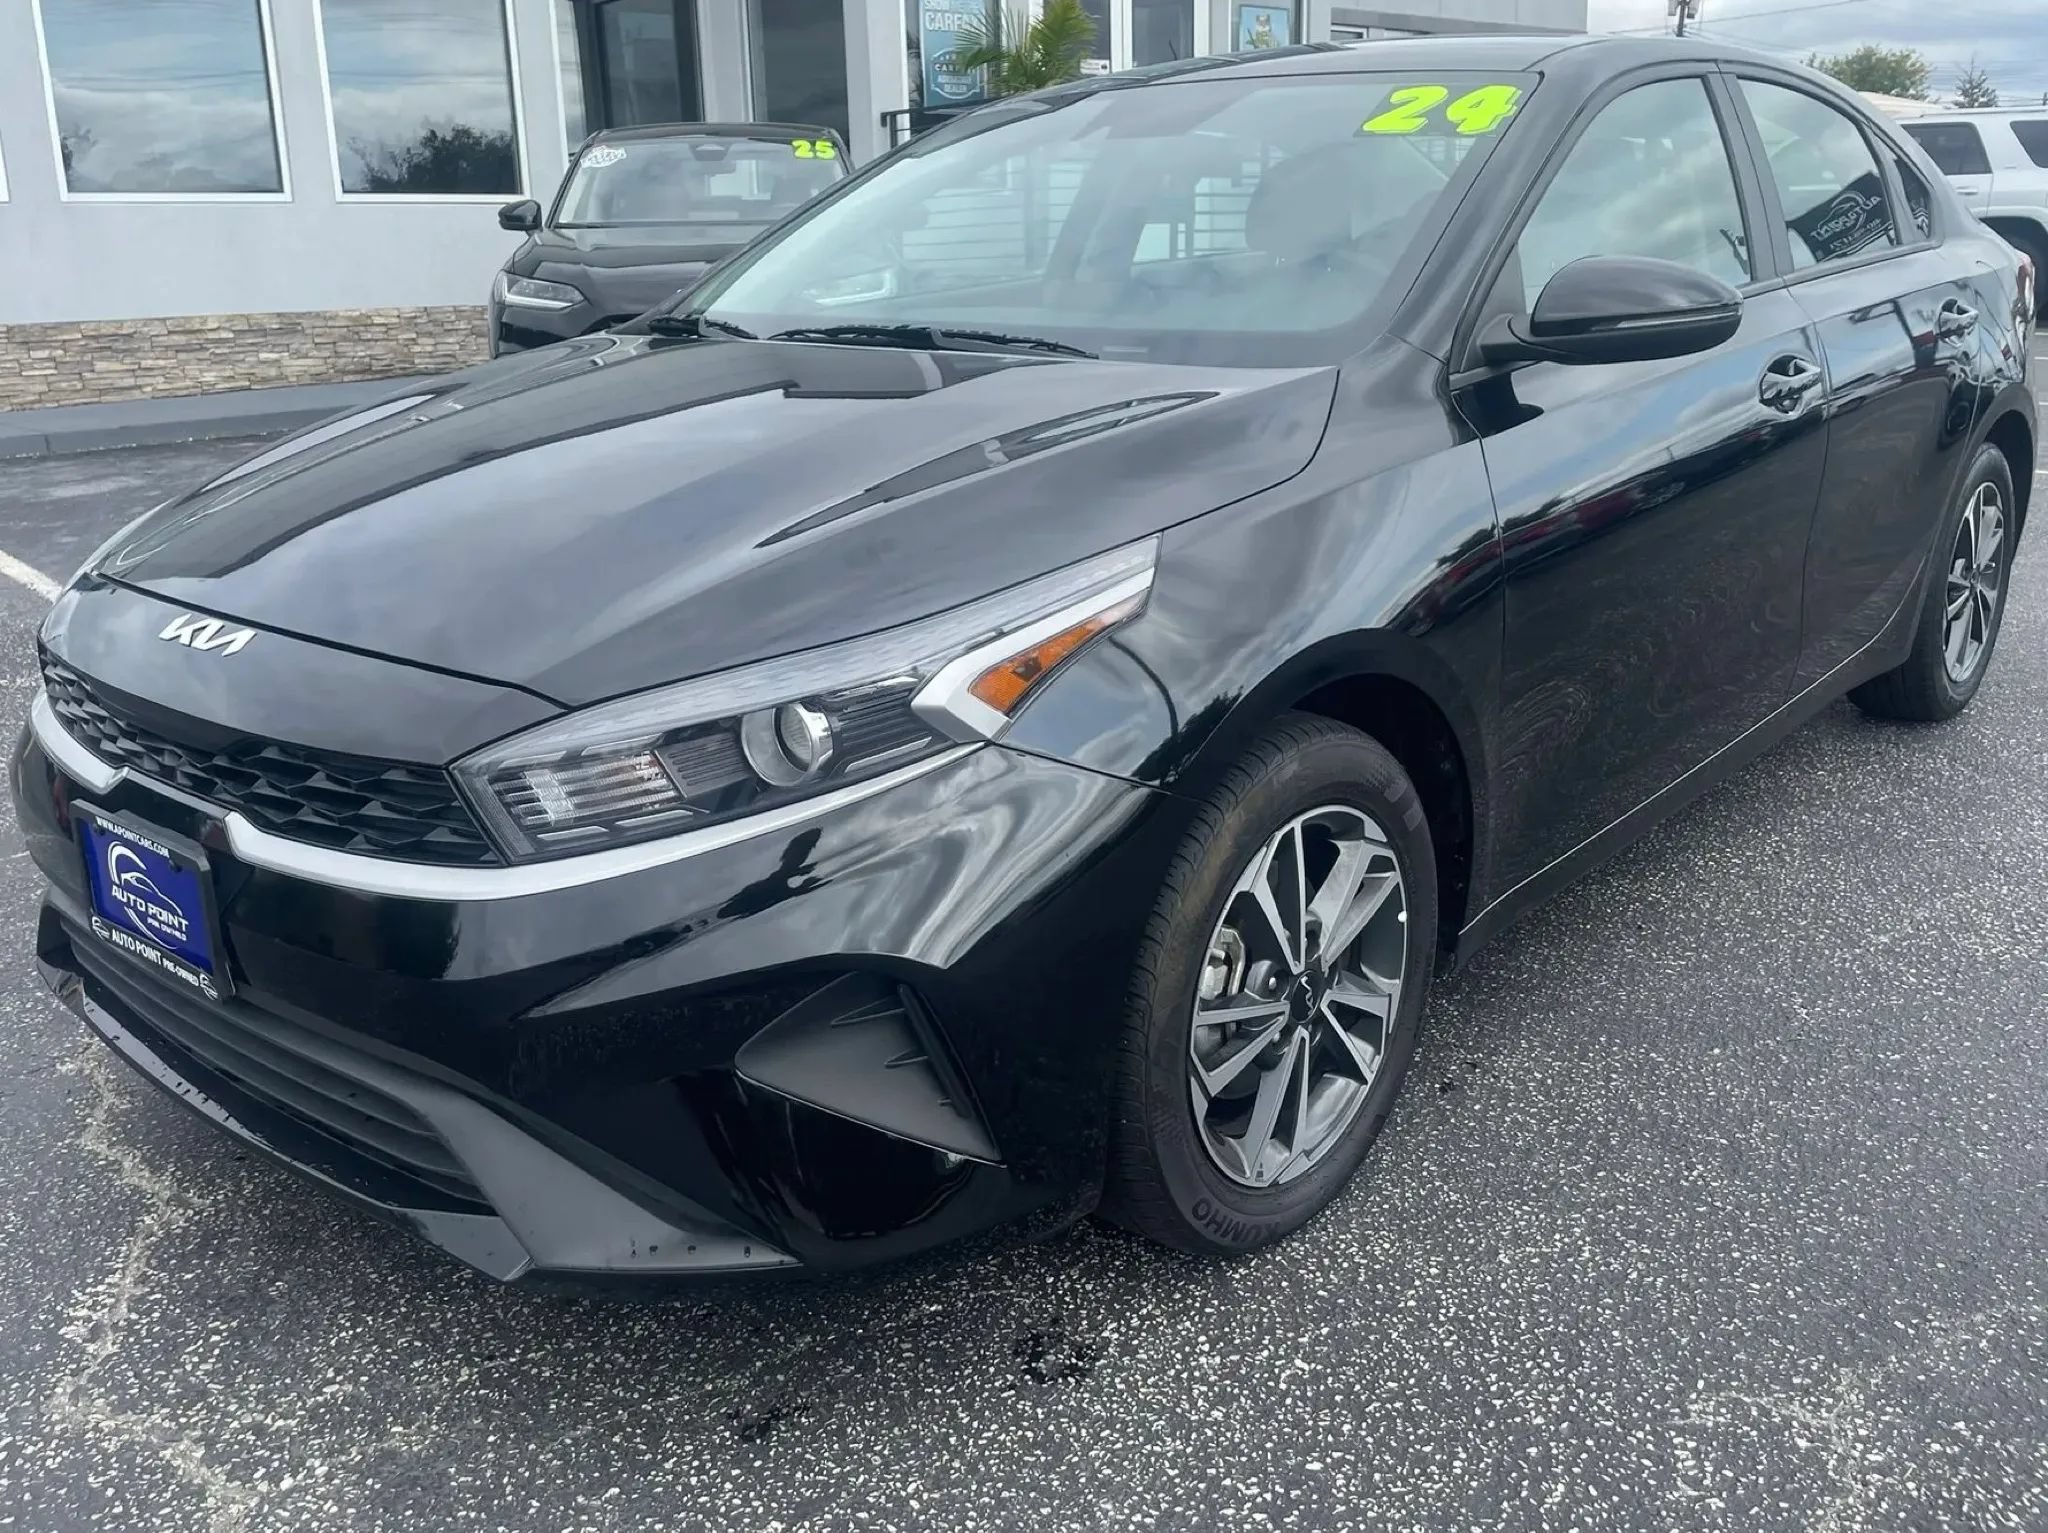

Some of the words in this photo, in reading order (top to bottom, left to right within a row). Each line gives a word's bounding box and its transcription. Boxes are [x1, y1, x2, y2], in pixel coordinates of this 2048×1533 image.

[1362, 84, 1522, 136] 24
[791, 138, 836, 160] 25
[158, 613, 257, 657] KIA
[111, 885, 146, 911] AUTO
[146, 902, 190, 932] POINT
[112, 929, 135, 951] AUTO
[136, 941, 163, 965] POINT
[163, 957, 200, 987] PRE-OWNED
[1191, 1197, 1281, 1243] KUMHO
